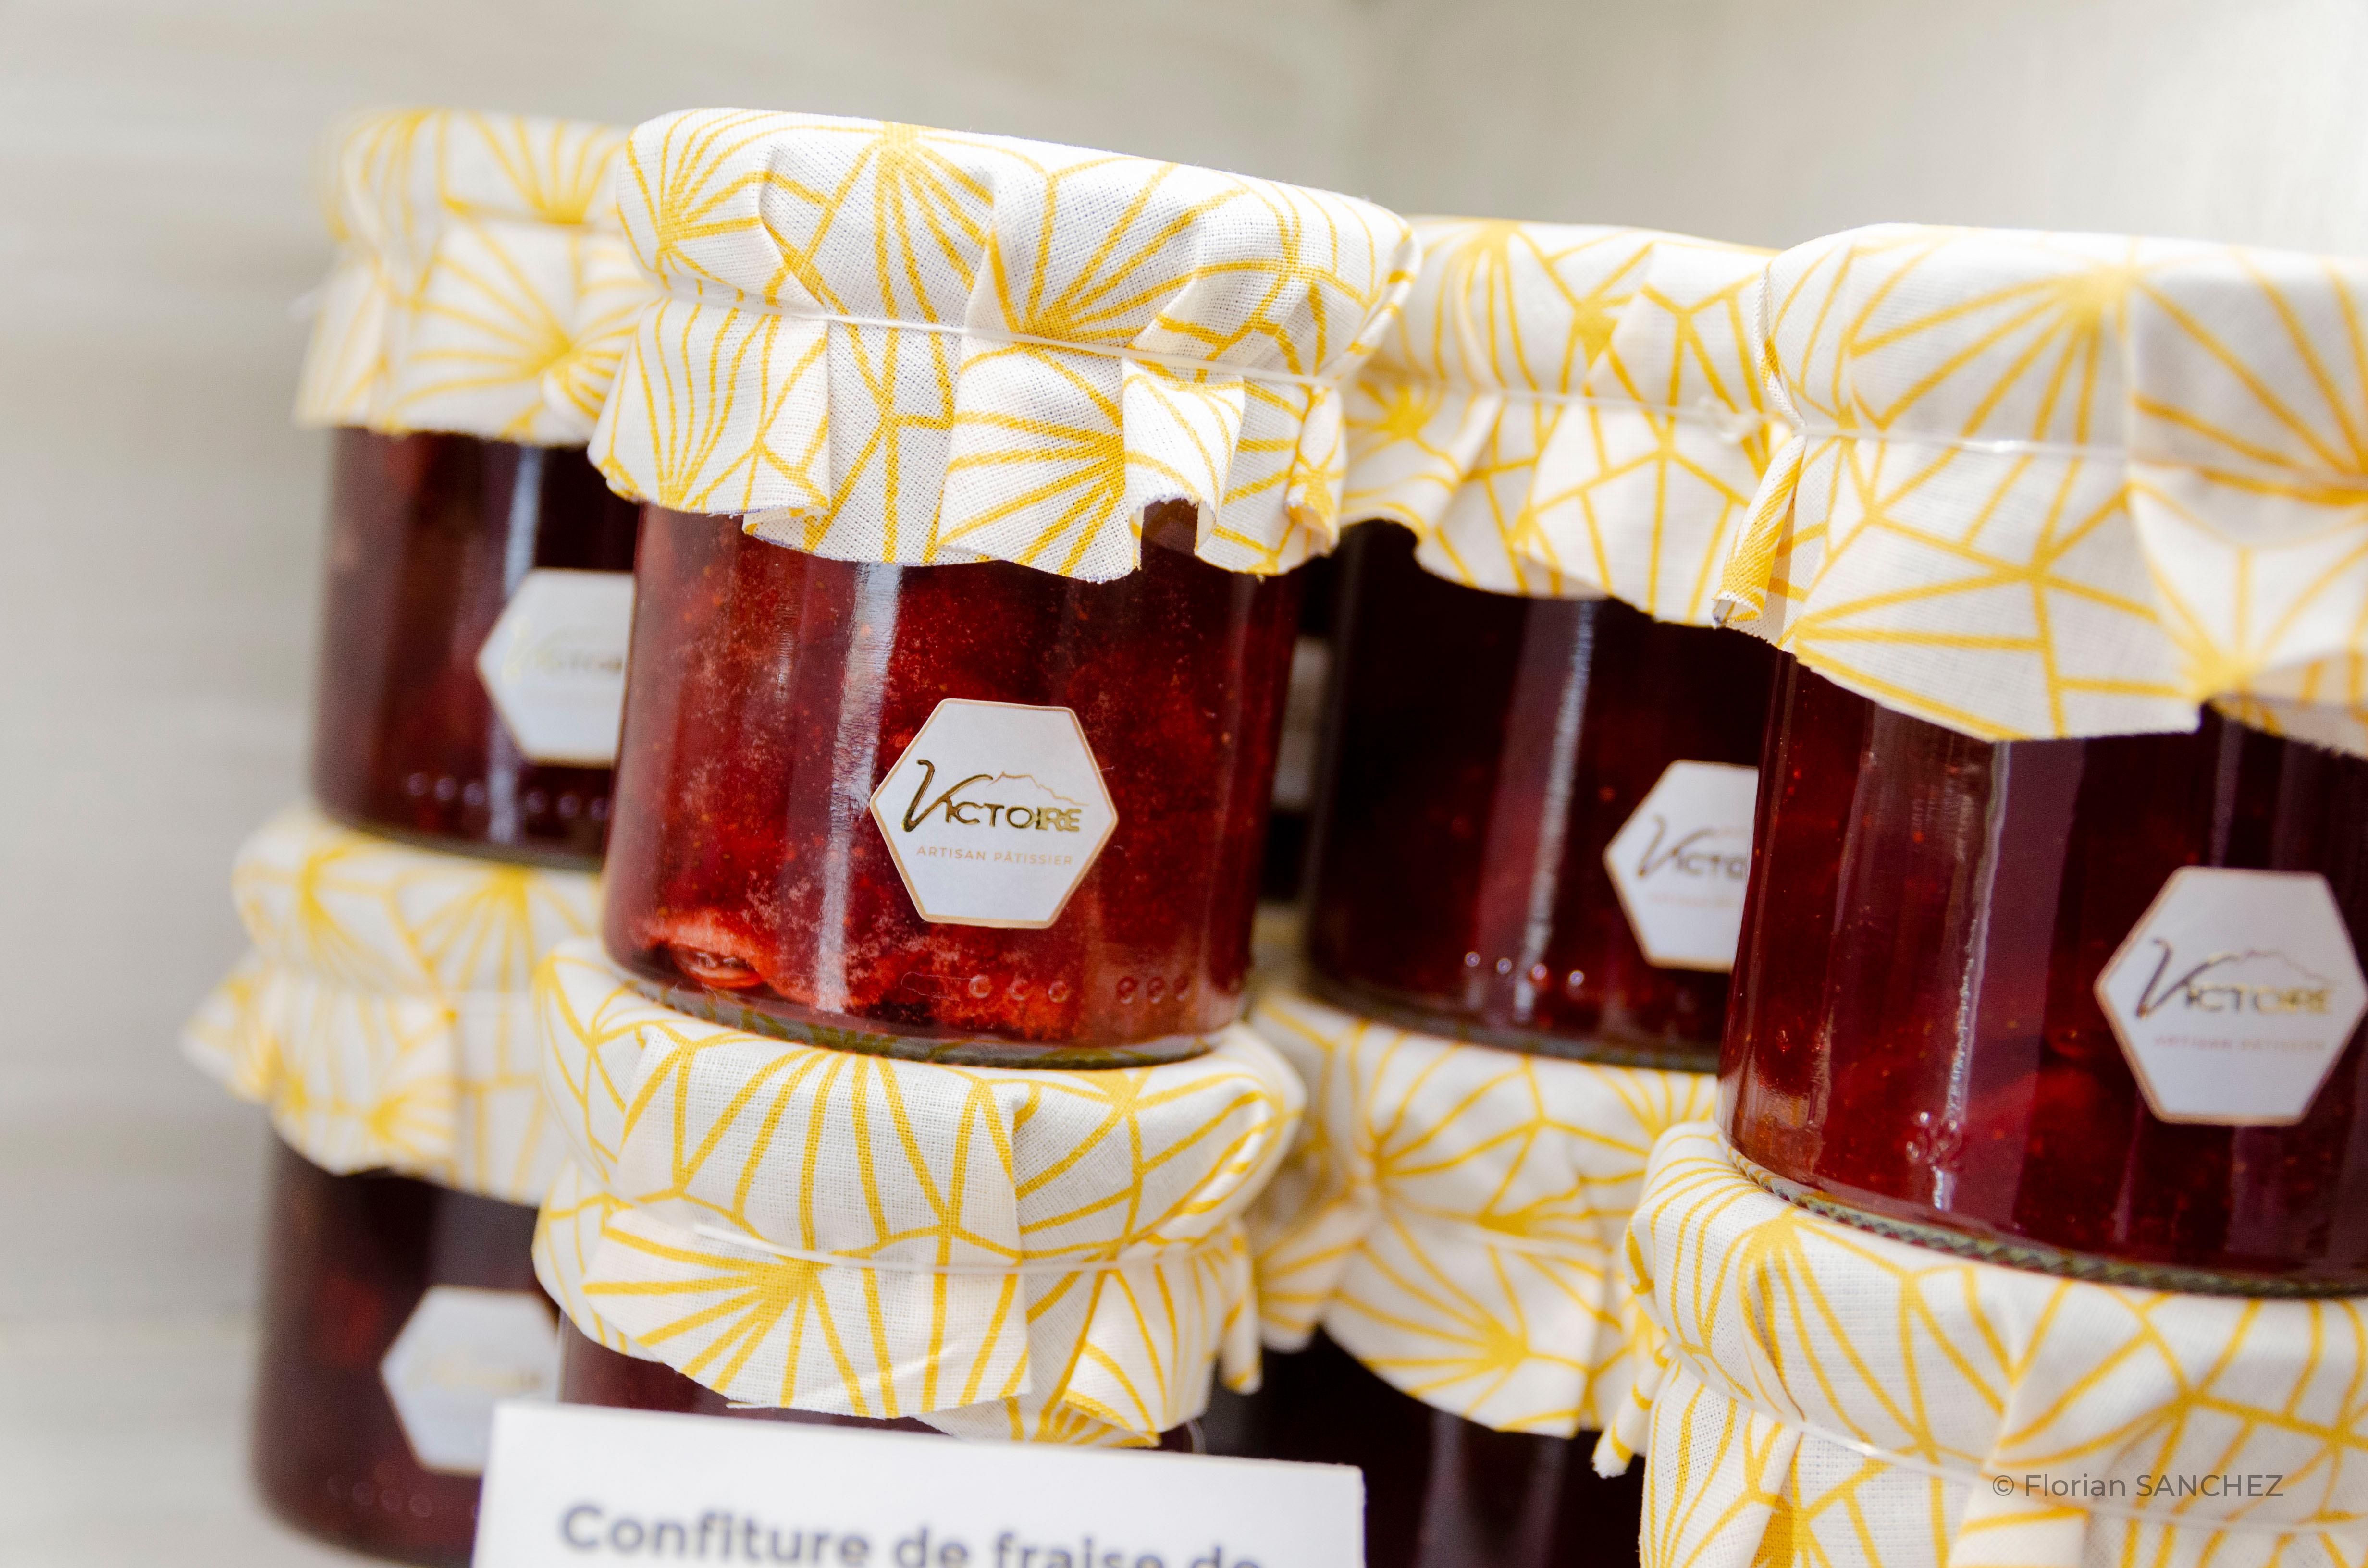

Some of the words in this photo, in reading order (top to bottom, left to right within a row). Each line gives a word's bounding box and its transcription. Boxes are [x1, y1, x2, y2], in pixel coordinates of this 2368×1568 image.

[916, 845, 986, 861] ARTISAN
[994, 850, 1073, 865] PÂTISSIER
[559, 1504, 871, 1566] Confiture
[893, 1527, 970, 1568] de
